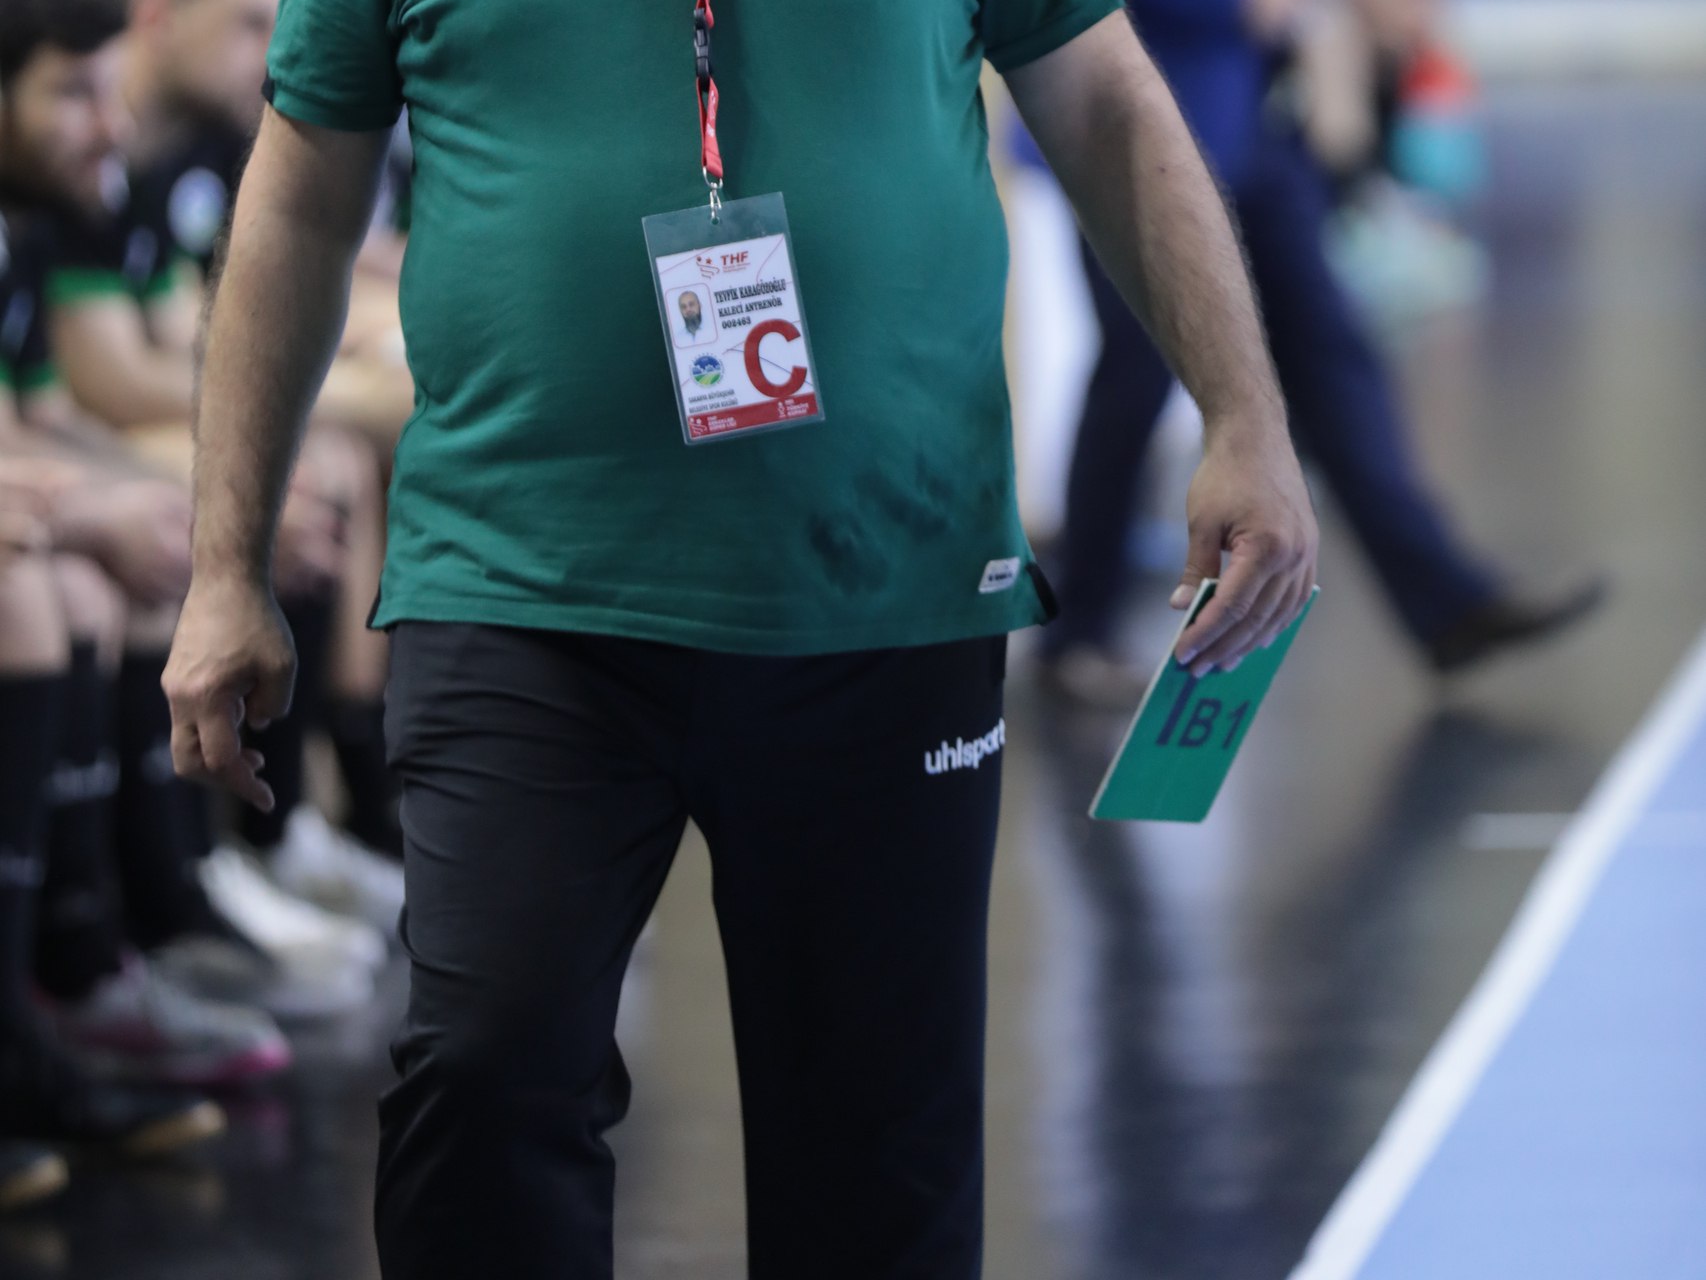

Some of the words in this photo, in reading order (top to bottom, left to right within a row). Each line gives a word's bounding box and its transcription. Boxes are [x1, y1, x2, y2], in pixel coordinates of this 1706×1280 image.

[720, 250, 749, 266] THF
[713, 285, 739, 303] TEVFİK
[718, 301, 744, 317] KALECİ
[721, 315, 752, 329] 002463
[743, 318, 808, 399] C
